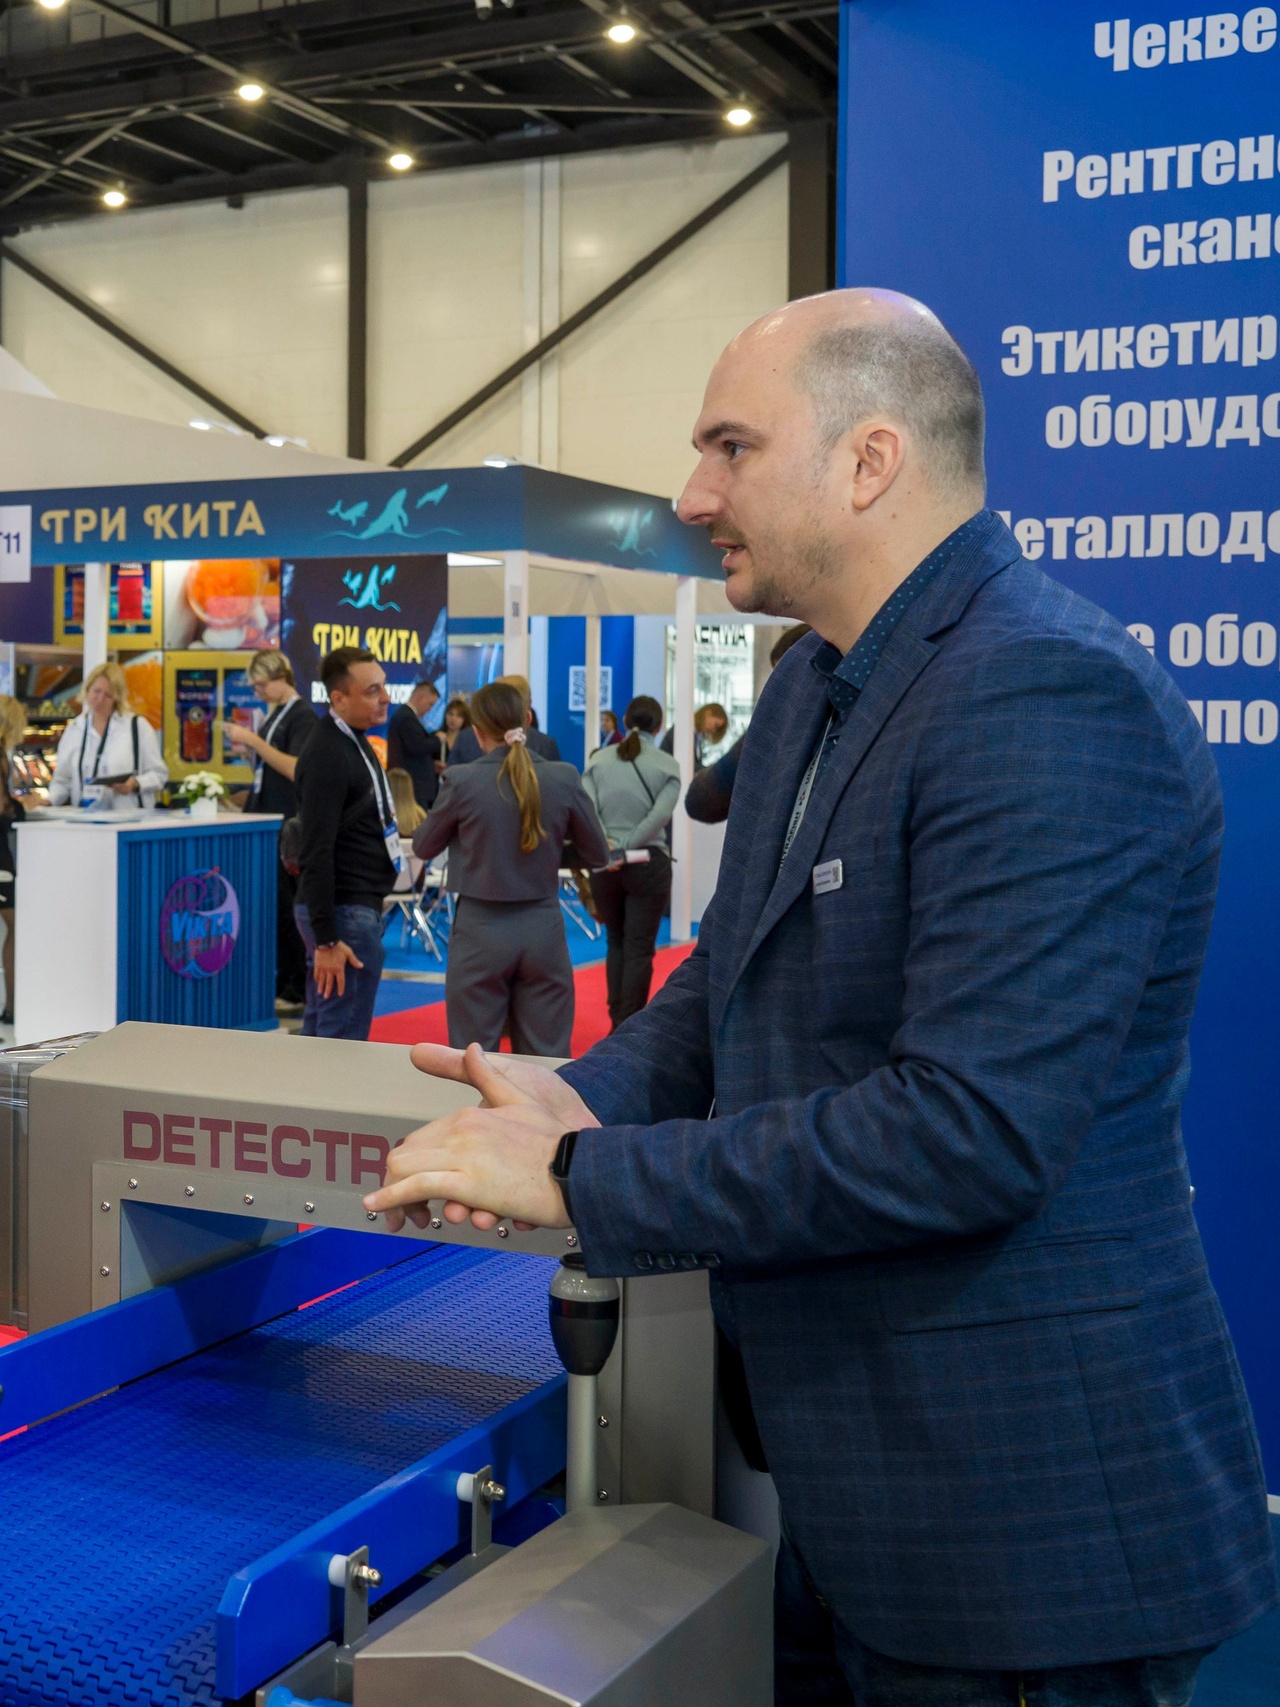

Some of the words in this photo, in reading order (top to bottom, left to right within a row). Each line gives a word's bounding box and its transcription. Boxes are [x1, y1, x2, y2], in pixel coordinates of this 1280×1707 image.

[1094, 6, 1277, 72] Чекве
[1043, 134, 1280, 203] Рентген
[1128, 213, 1280, 269] скан
[1001, 314, 1277, 377] Этикетир
[40, 506, 126, 544] ТРИ
[144, 500, 266, 539] КИТА
[998, 509, 1280, 564] еталлод
[313, 623, 359, 658] ТРИ
[366, 627, 422, 664] КИТА
[1169, 613, 1280, 671] обо
[1187, 700, 1278, 745] по
[123, 1110, 406, 1187] DETECTR
